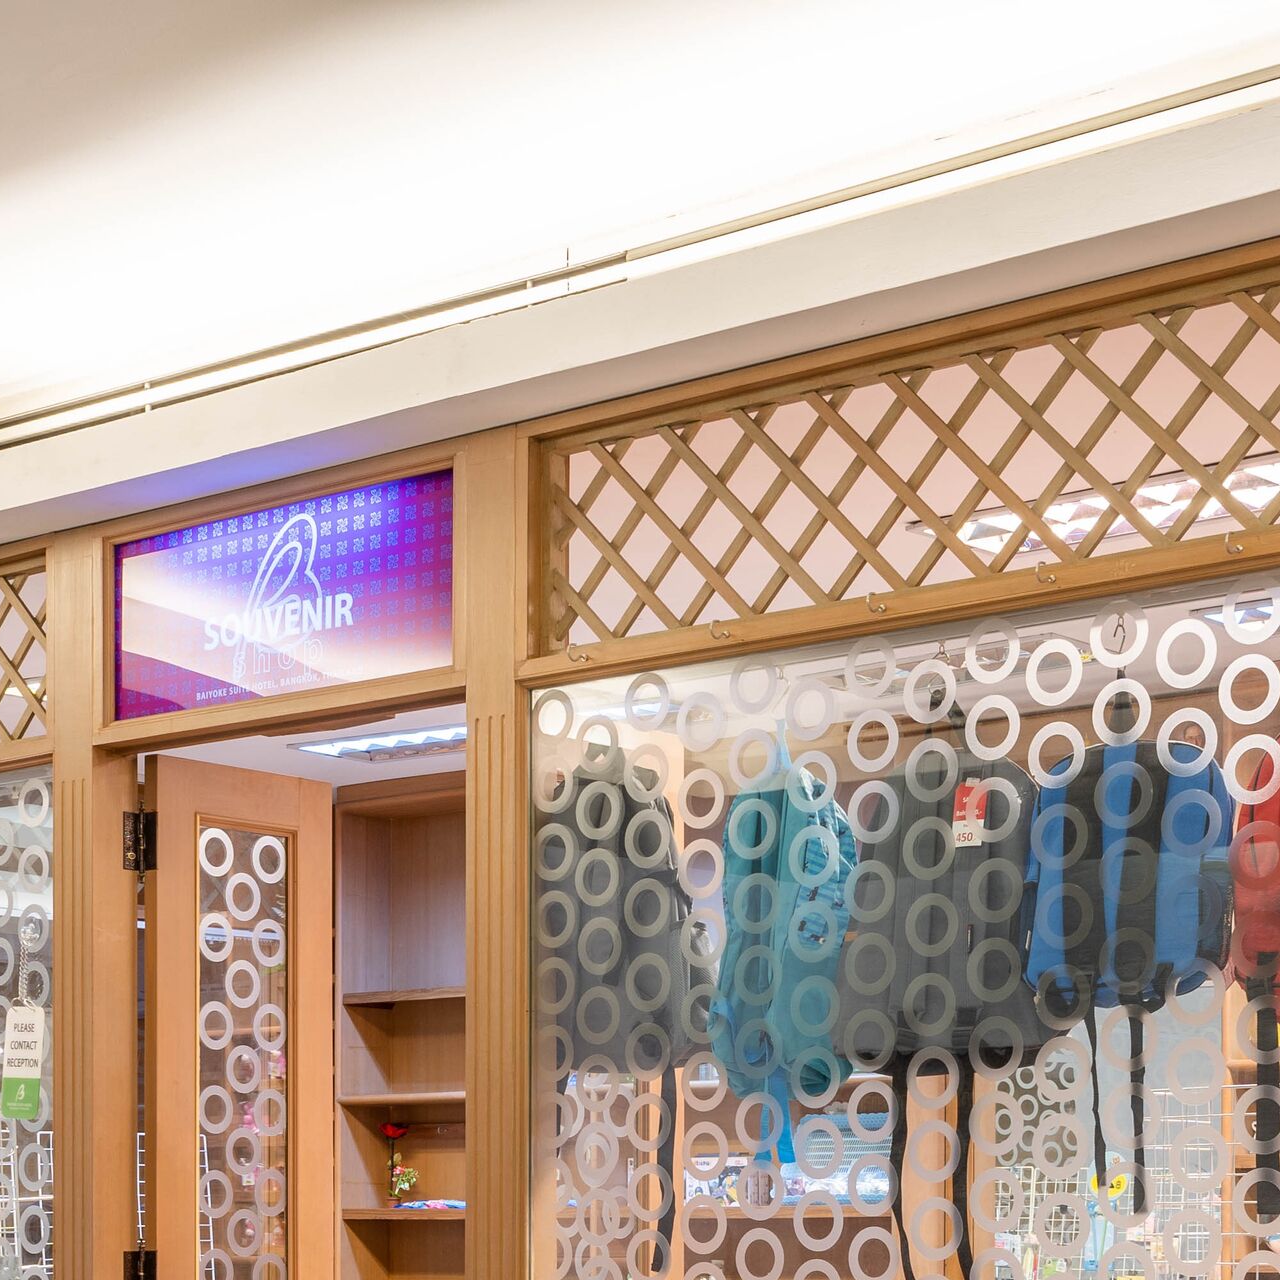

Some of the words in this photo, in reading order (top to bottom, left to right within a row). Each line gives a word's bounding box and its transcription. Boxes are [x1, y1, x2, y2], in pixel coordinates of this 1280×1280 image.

[203, 592, 354, 652] SOUVENIR
[232, 637, 324, 679] shop
[196, 687, 228, 701] BAIYOKE
[13, 1022, 36, 1033] PLEASE
[10, 1040, 38, 1051] CONTACT
[6, 1057, 40, 1068] RECEPTION
